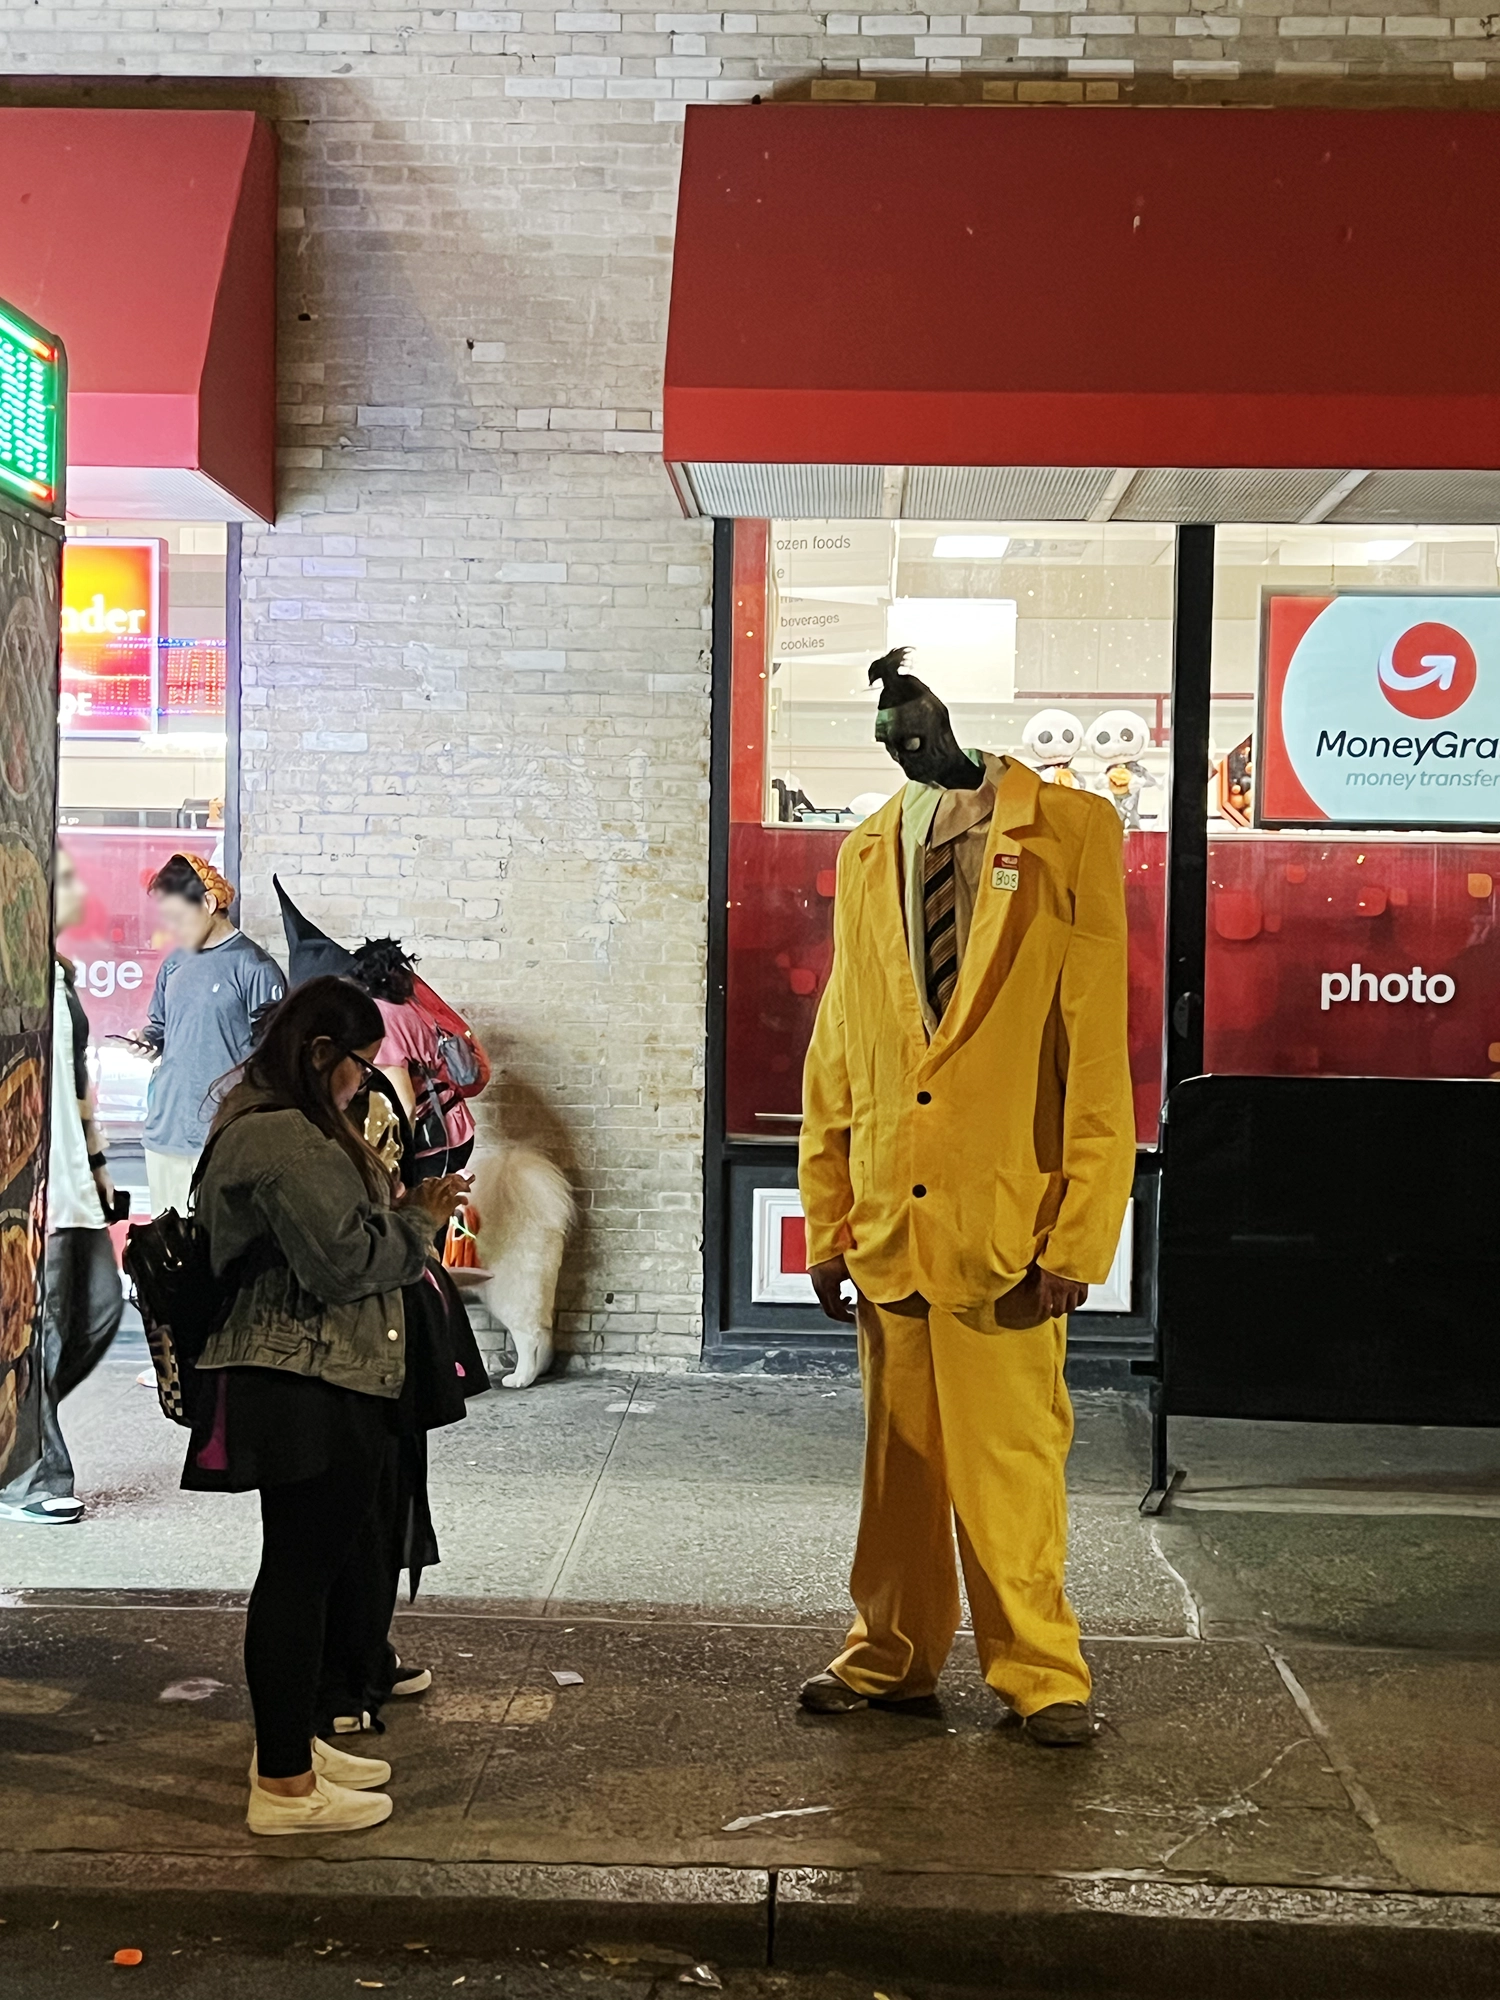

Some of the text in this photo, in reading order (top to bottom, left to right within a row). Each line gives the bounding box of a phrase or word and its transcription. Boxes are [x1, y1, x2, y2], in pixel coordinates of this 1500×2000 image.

[813, 535, 851, 549] foods
[780, 614, 840, 628] beverages
[780, 637, 825, 650] cookies
[1316, 730, 1500, 766] MoneyGra
[1345, 769, 1500, 790] money transfer
[1320, 963, 1456, 1011] photo
